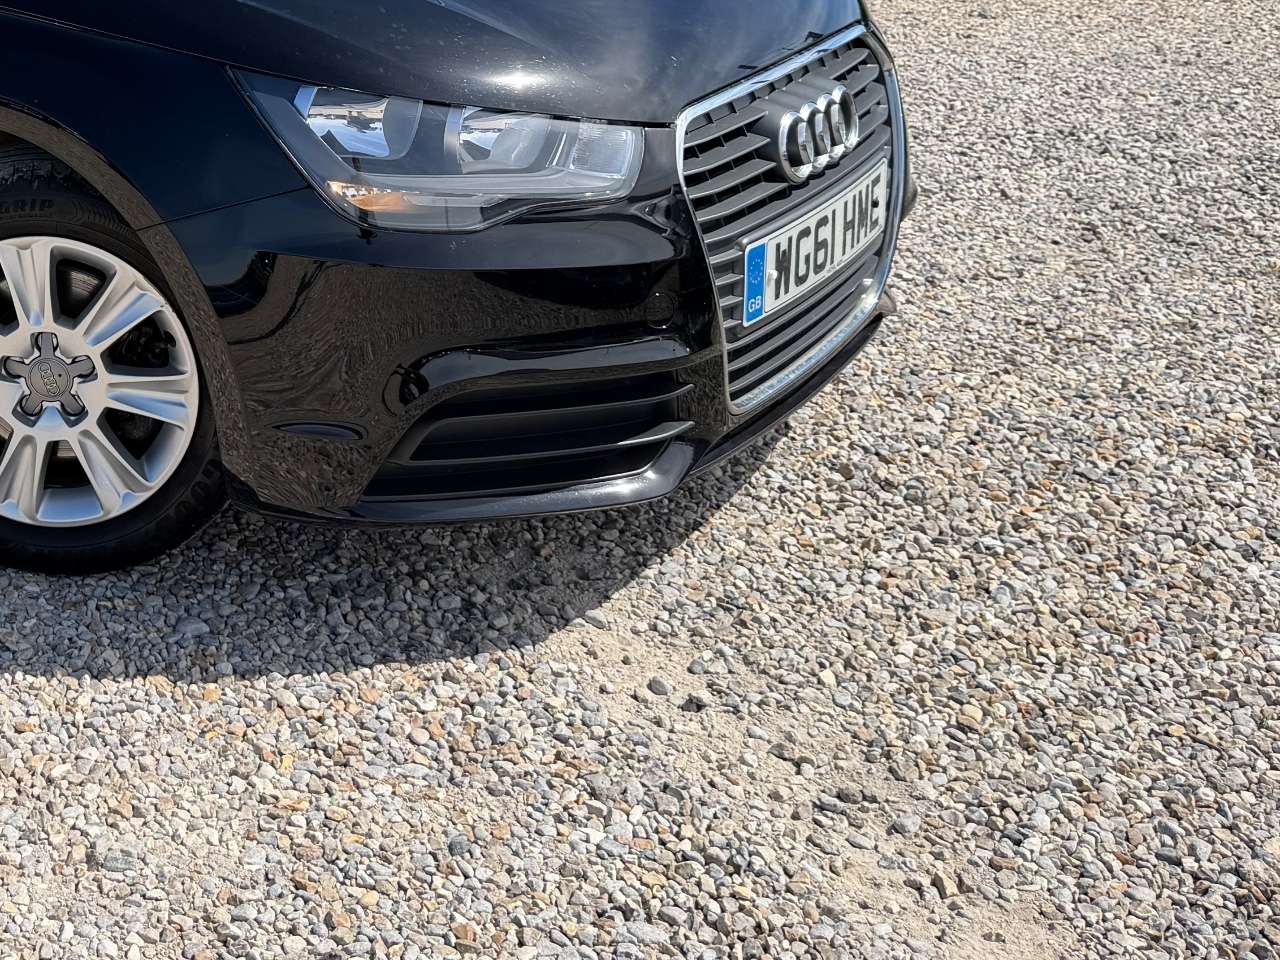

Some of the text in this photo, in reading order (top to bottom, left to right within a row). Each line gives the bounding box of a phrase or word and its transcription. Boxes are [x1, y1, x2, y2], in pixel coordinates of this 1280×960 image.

[774, 173, 881, 301] WG61 HME
[748, 295, 762, 313] GB
